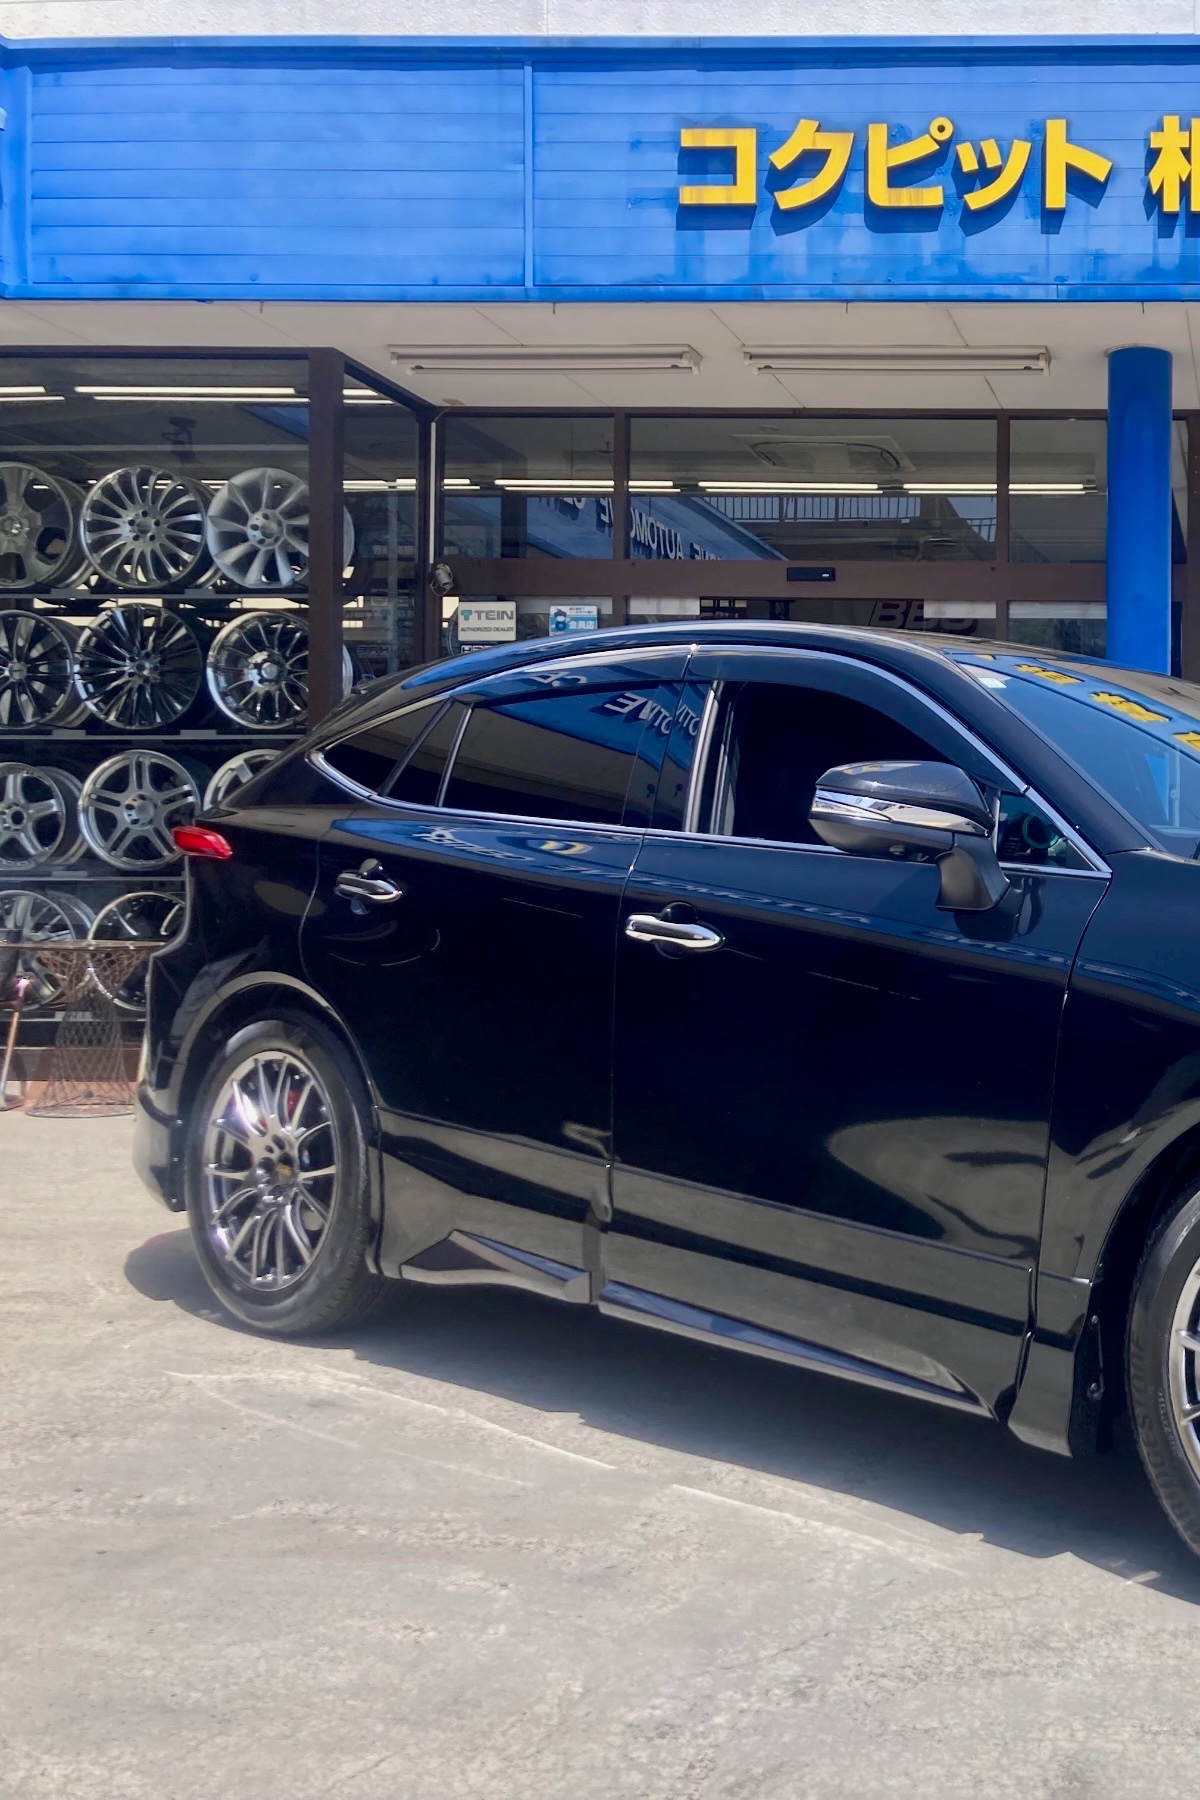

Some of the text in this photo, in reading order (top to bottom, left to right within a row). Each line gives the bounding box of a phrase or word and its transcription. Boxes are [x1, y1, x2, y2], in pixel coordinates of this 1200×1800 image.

[679, 115, 1112, 211] コクピット
[474, 610, 514, 620] TEIN
